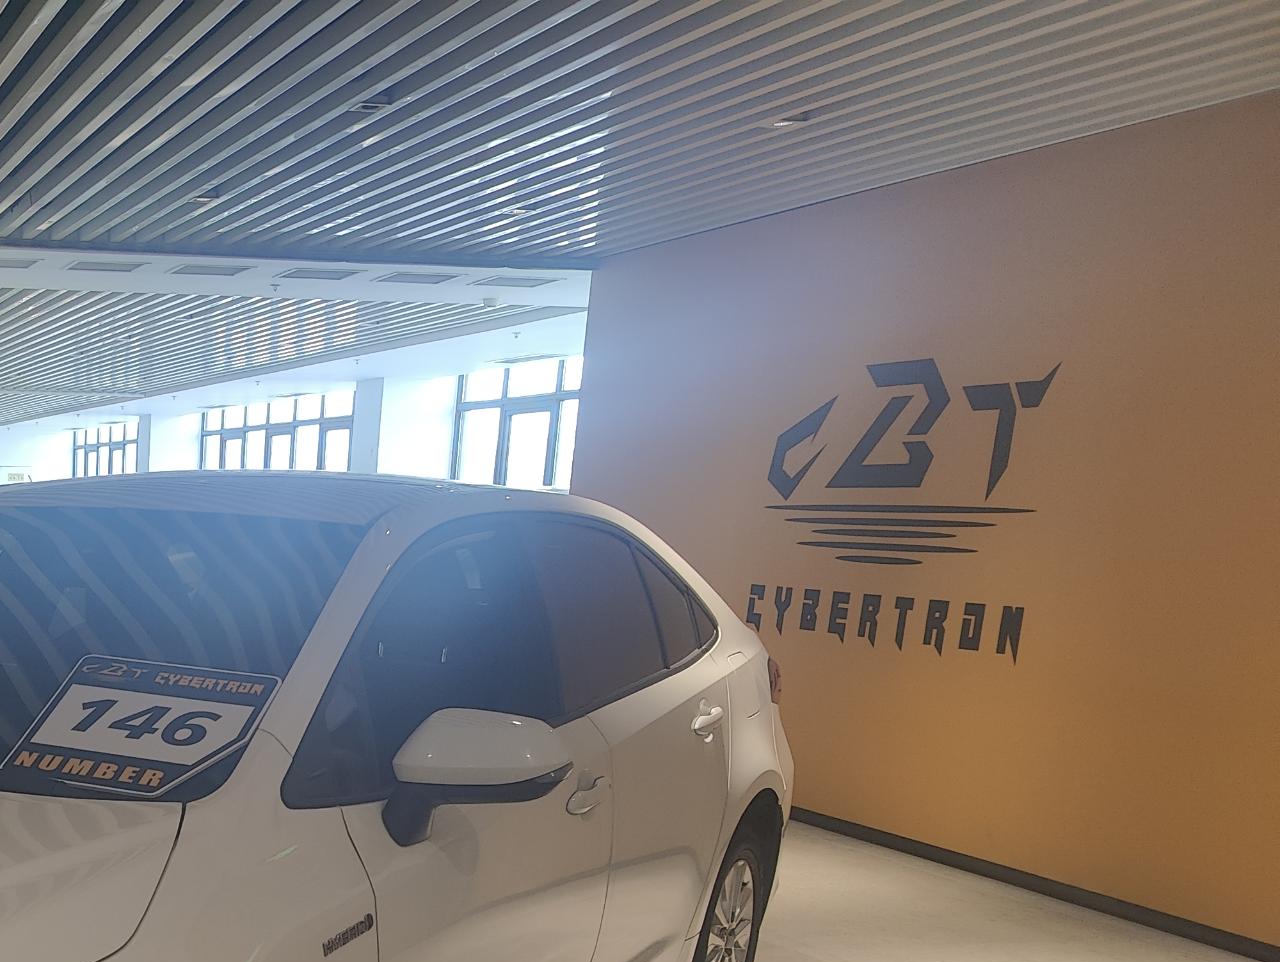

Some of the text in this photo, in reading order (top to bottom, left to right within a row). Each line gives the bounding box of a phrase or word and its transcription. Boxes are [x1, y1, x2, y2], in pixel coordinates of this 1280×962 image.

[745, 583, 1024, 666] CYBERTRON
[153, 671, 266, 697] CYBERTRON
[71, 698, 223, 747] 146
[14, 750, 166, 789] NUMBER
